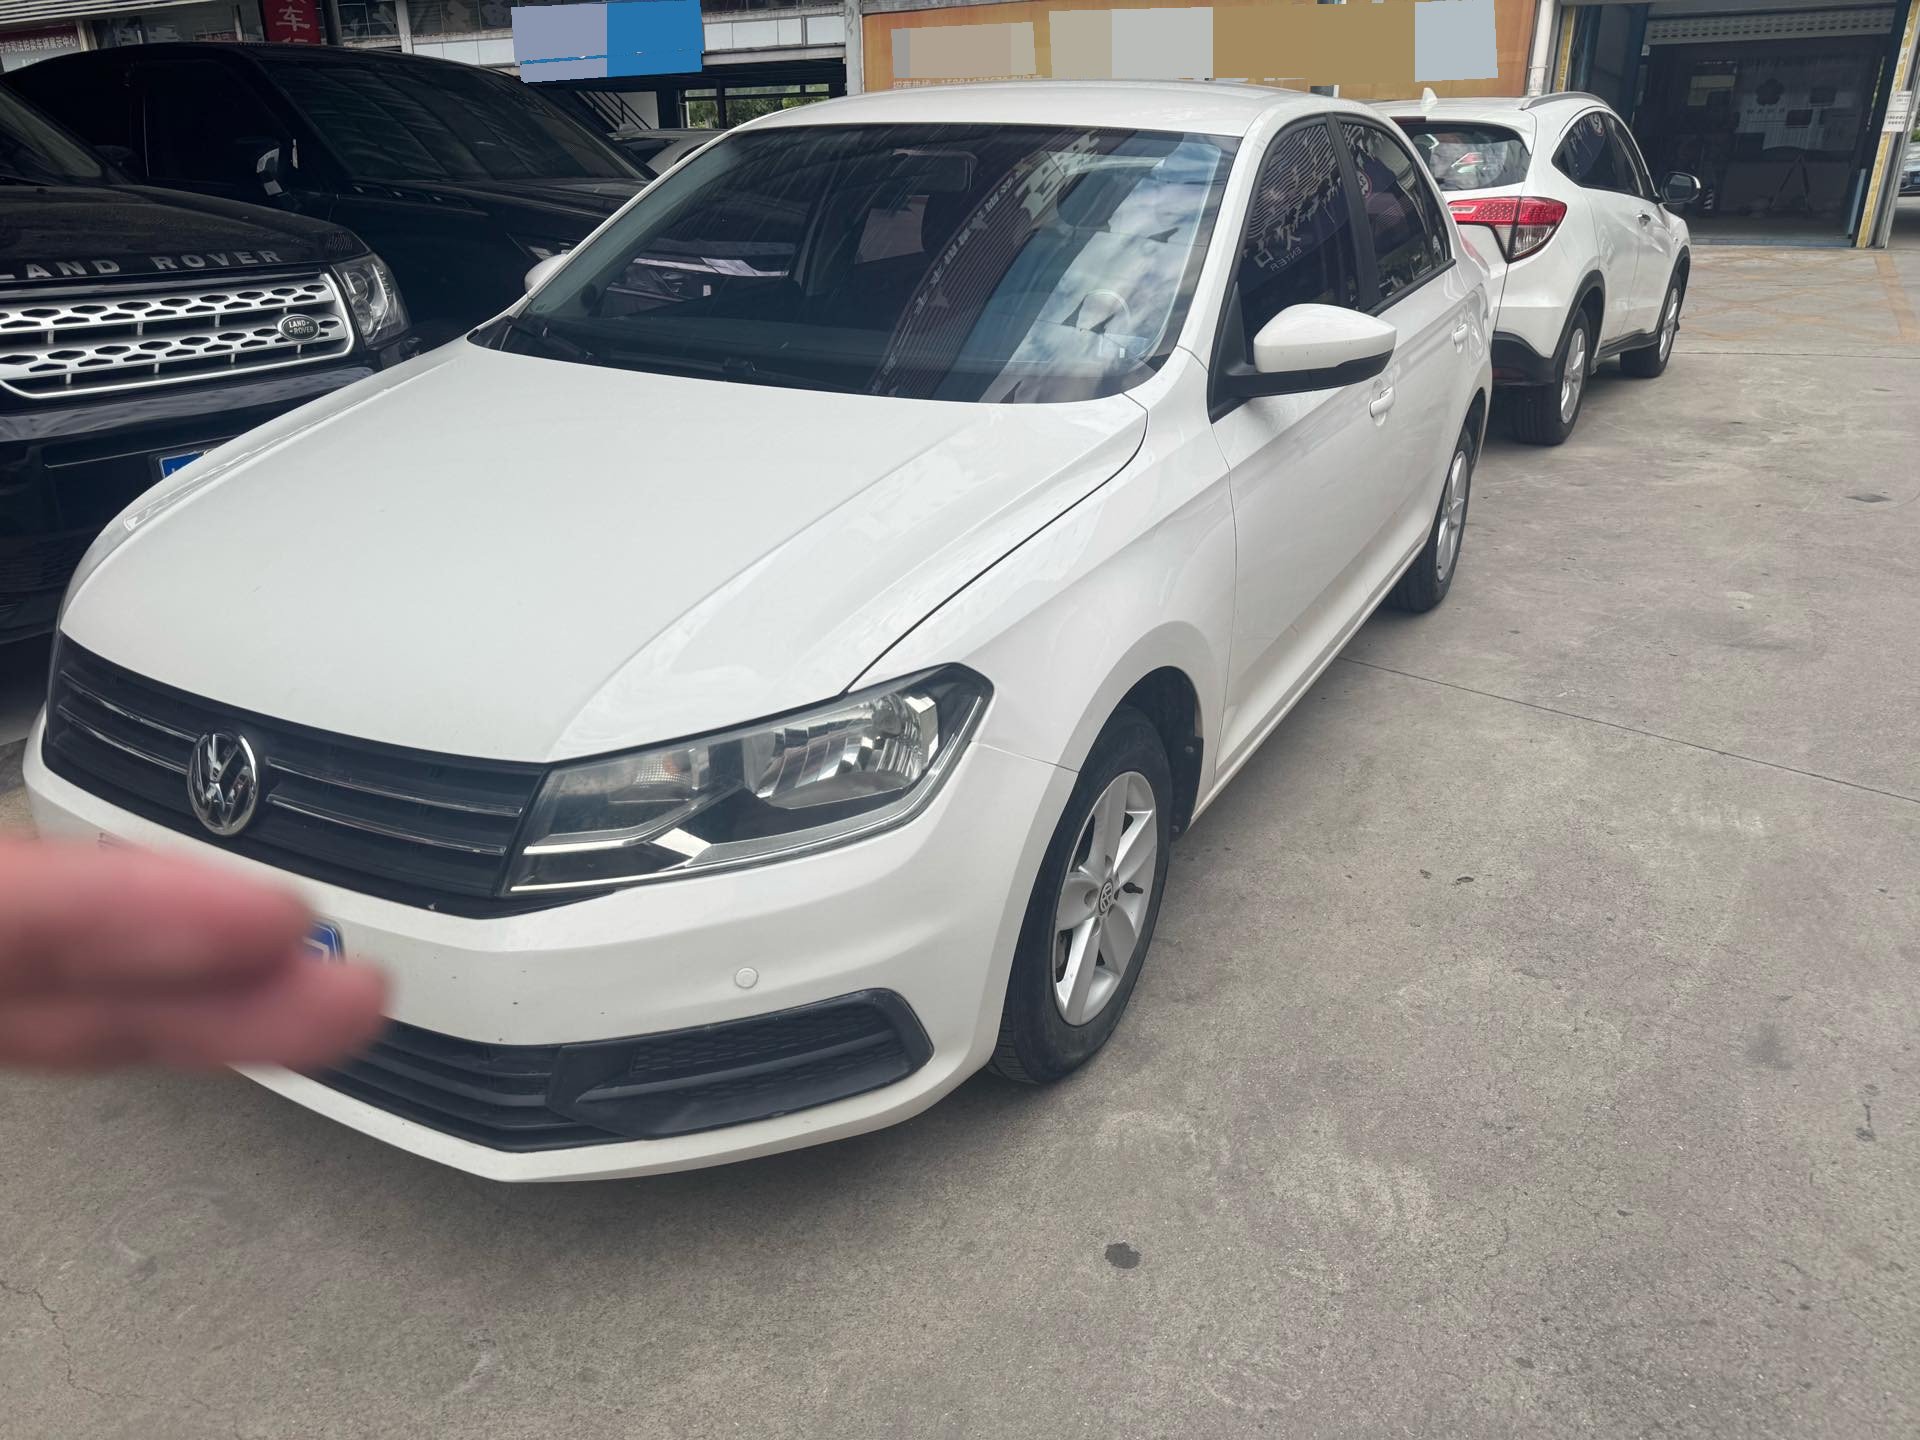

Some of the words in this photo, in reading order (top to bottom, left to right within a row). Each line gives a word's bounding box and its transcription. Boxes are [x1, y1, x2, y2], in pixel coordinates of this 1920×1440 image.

[150, 250, 282, 271] ROVER
[289, 319, 306, 328] LAND
[293, 325, 314, 334] ROVER
